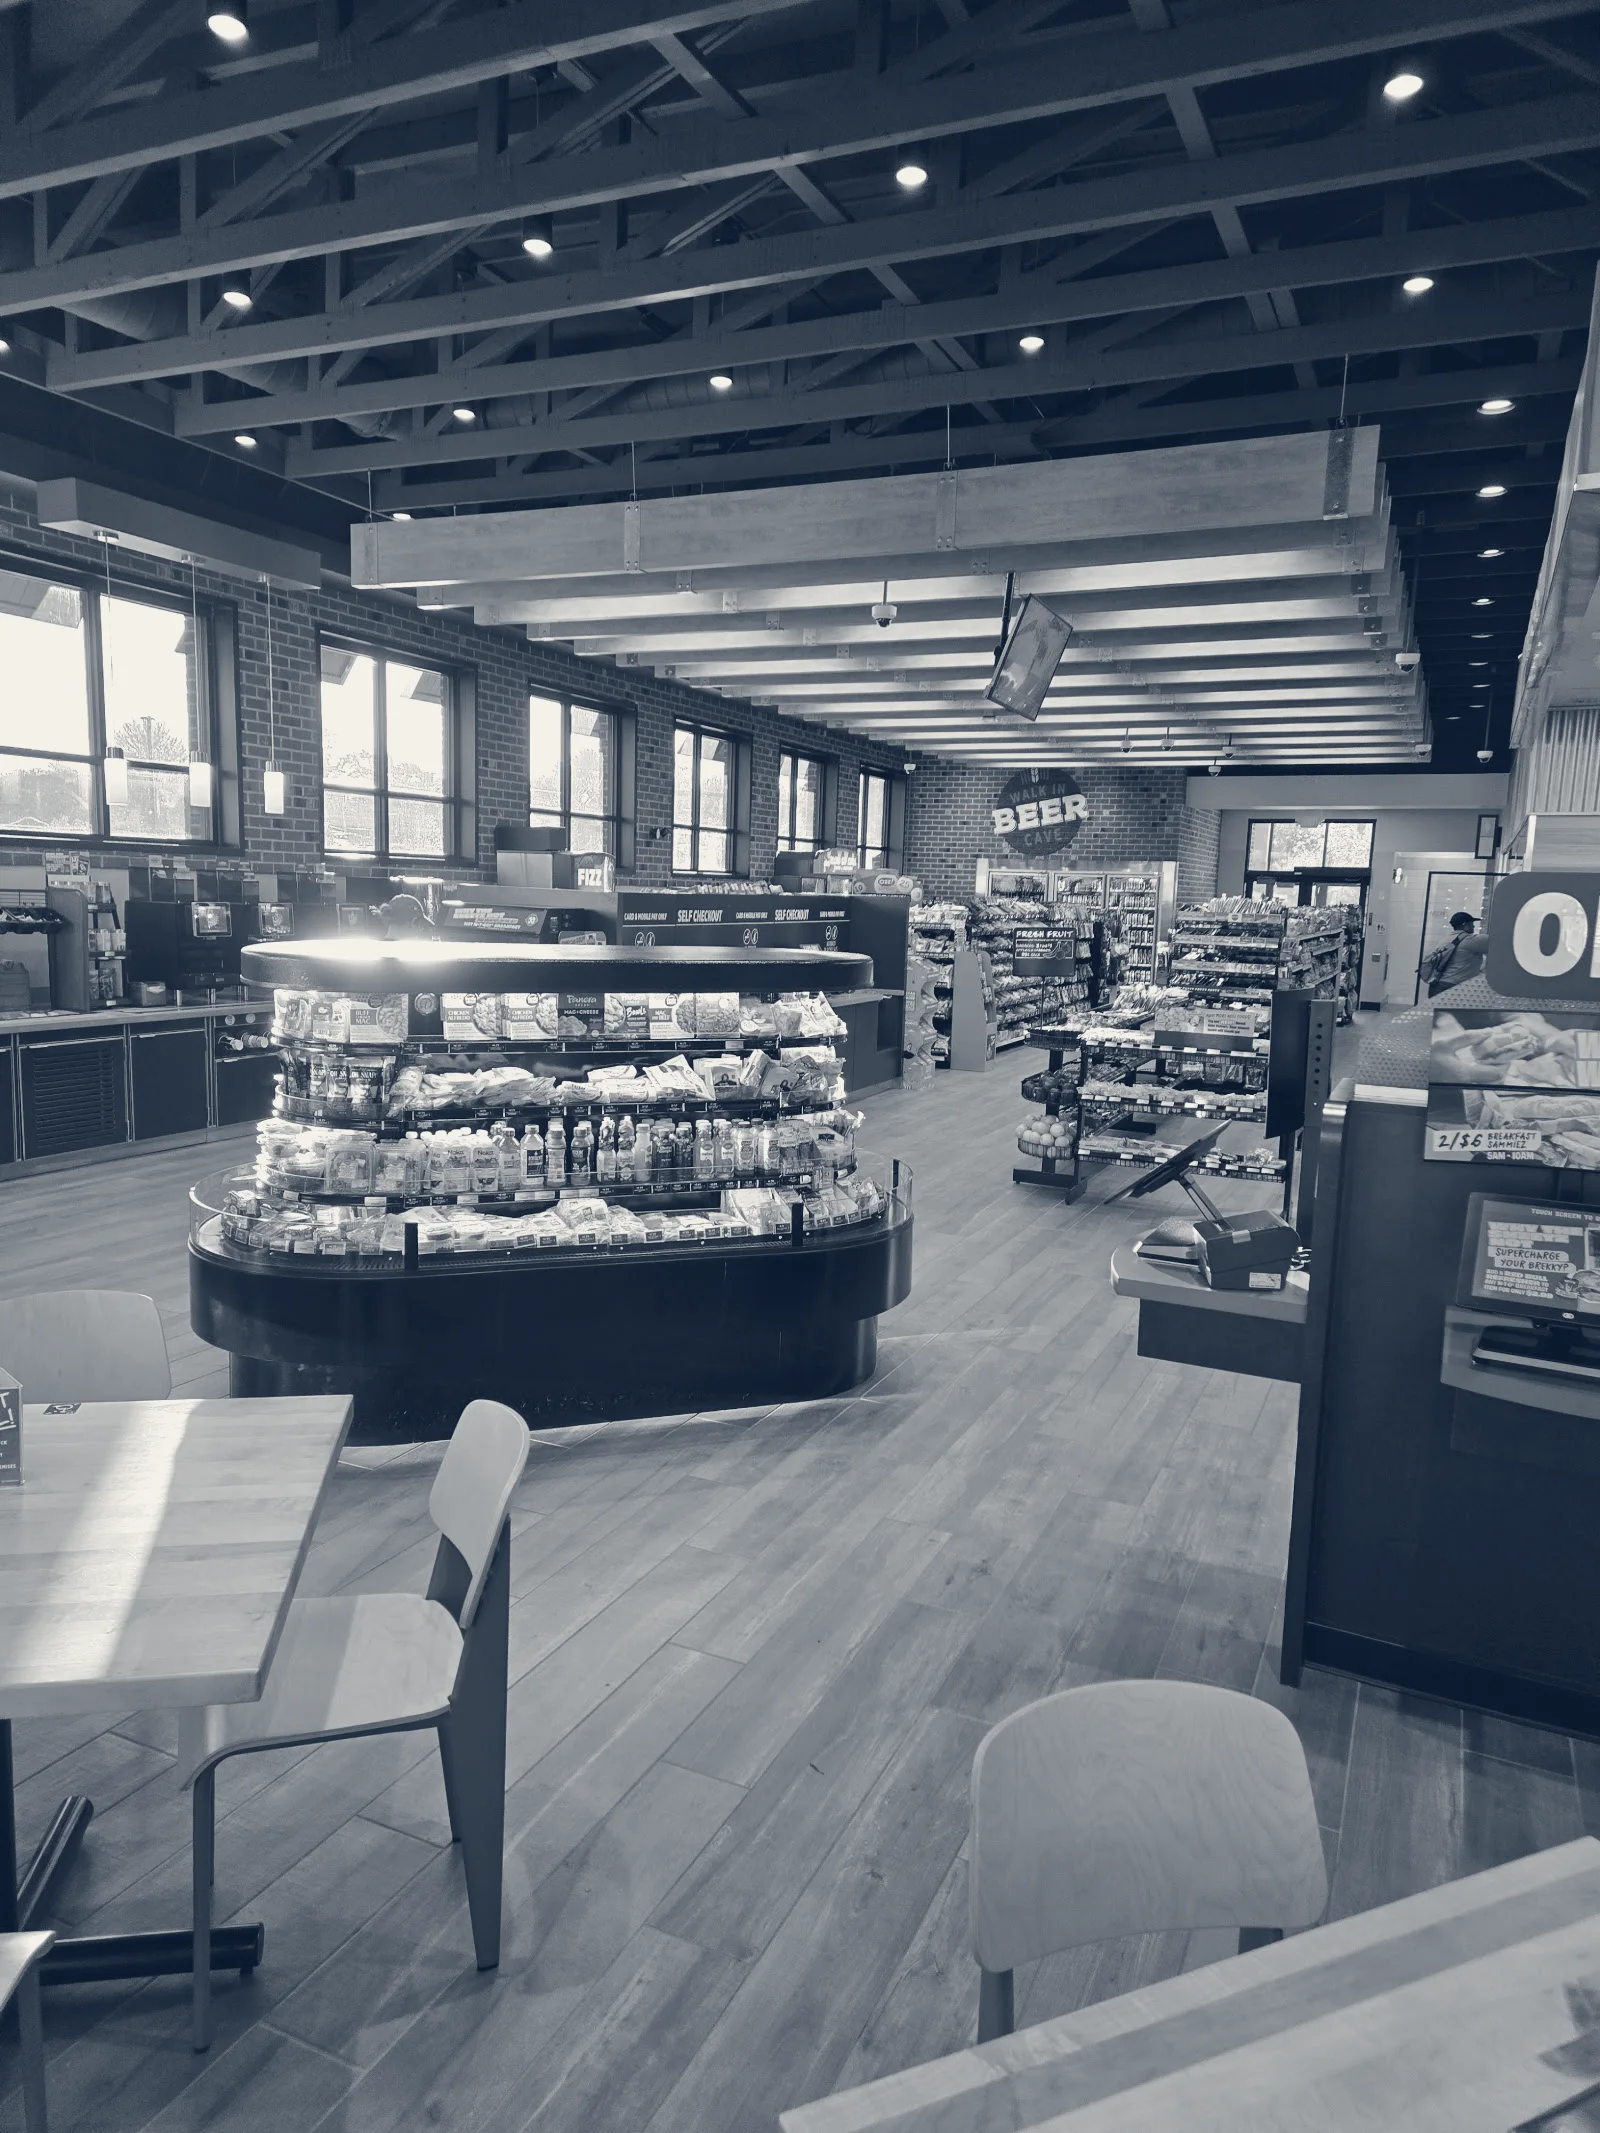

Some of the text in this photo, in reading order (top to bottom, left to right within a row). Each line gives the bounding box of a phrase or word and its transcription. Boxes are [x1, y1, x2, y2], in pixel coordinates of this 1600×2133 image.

[1009, 783, 1066, 803] WALK IN
[992, 793, 1090, 835] BEER
[1024, 828, 1062, 846] CAVE
[577, 868, 602, 886] FIZZ
[677, 910, 723, 922] SELF CHECKOUT
[775, 909, 809, 921] SELF CHECKOUT
[1046, 930, 1073, 938] FRUIT
[567, 995, 597, 1003] Panera
[1438, 1132, 1483, 1150] 2/$6
[1488, 1132, 1536, 1140] BREAKFAST
[1487, 1140, 1527, 1149] SAMMIEZ
[1531, 1208, 1553, 1216] TOUCH
[1555, 1211, 1581, 1219] SCREEN
[1495, 1248, 1560, 1260] SUPERCHARGE
[1500, 1259, 1569, 1271] YOUR BREKKY?
